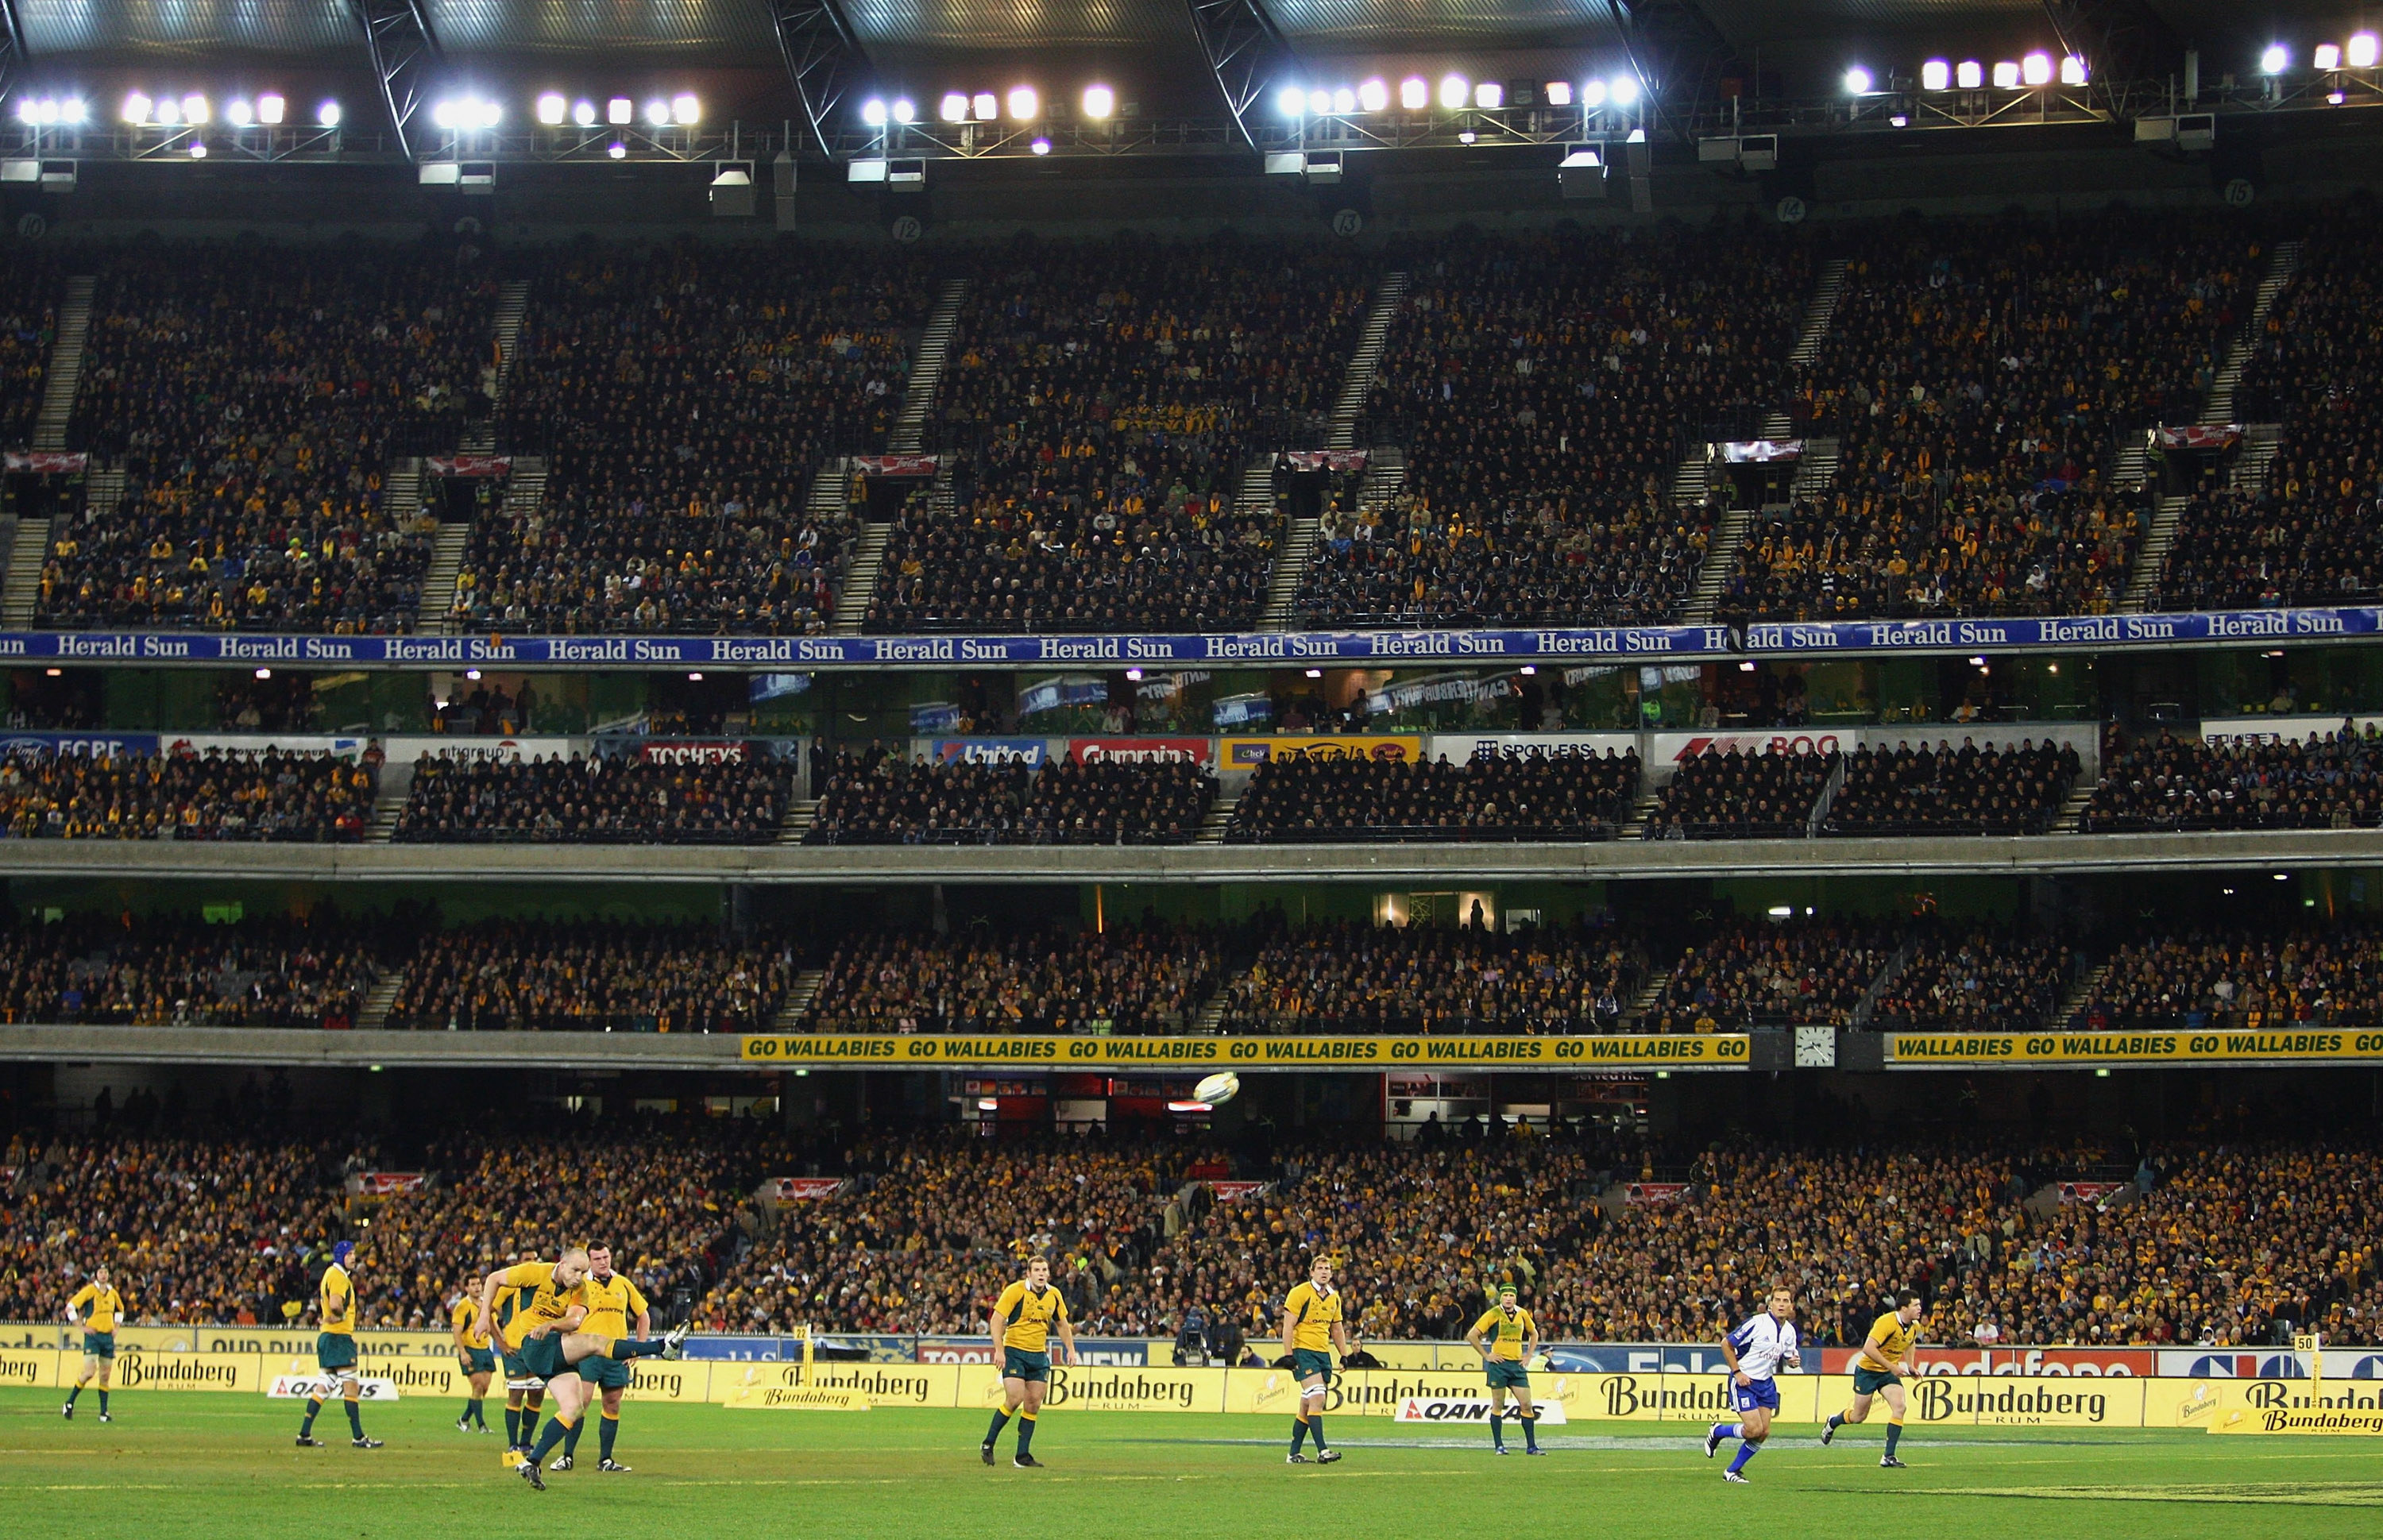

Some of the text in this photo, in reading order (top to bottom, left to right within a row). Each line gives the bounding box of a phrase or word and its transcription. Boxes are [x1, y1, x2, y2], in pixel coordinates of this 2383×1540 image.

[0, 612, 2343, 661] un Herald Sun Herald Sun Herald Sun Herald Sun Herald Sun Herald Sun Herald Sun Herald Sun Herald Sun Herald Sun Hald Sun Herald Sun Herald Sun Herald Sun
[748, 1040, 1746, 1059] GO WALLABIES GO WALLABIES GO WALLABIES GO WALLABIES GO WALLABIES GO WALLABIES GO
[1897, 1034, 2383, 1056] WALLABIES GO WALLABIES GO WALLABIES GO
[797, 1328, 807, 1340] 22
[2298, 1337, 2312, 1349] 50
[118, 1353, 236, 1387] Bundaberg
[763, 1388, 850, 1408] Bundaberg
[1601, 1376, 1780, 1418] Bundab
[1913, 1380, 2105, 1422] Bundaberg
